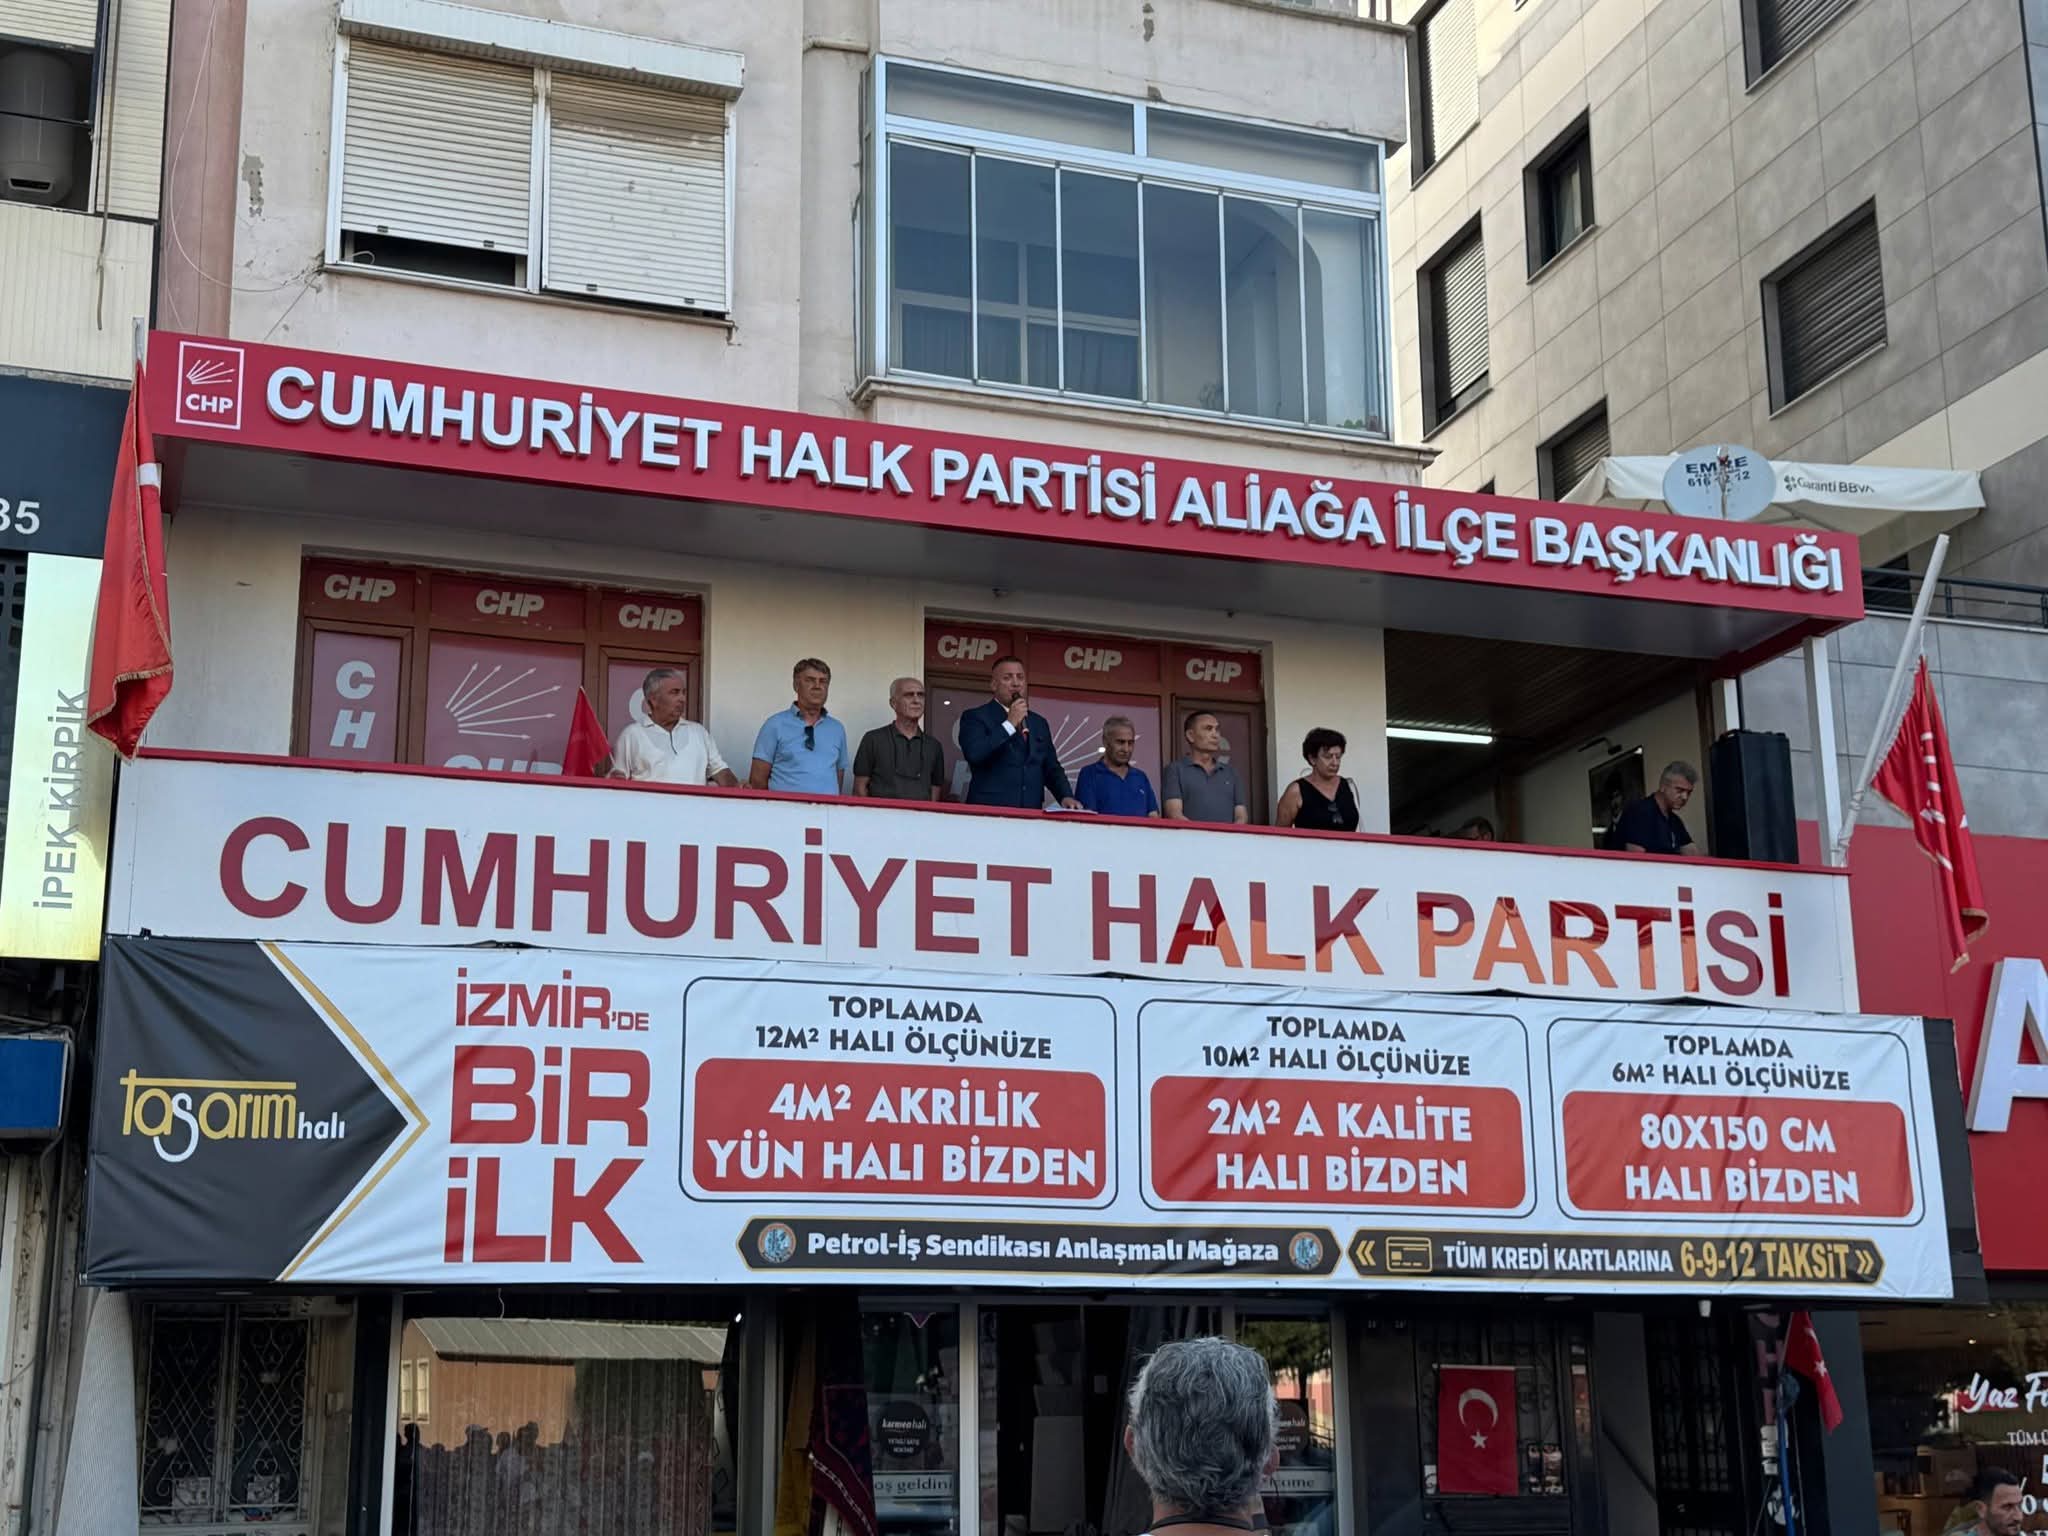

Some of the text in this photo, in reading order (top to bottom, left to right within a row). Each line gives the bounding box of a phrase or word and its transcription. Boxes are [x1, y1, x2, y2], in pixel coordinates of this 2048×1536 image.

[185, 392, 234, 414] CHP
[266, 366, 1844, 593] CUMHURİYET HALK PARTİSİ ALİAĞA İLÇE BAŞKANLIĞI
[1797, 476, 1837, 493] Garanti
[324, 573, 396, 603] CHP
[475, 589, 545, 618] CHP
[618, 604, 685, 632] CHP
[937, 635, 998, 661] CHP
[1063, 646, 1123, 672] CHP
[1185, 658, 1242, 684] CHP
[33, 689, 89, 909] İPEK KİRPİK
[219, 816, 1792, 998] CUMHURİYET HALK PARTİSİ
[828, 995, 983, 1025] TOPLAMDA
[756, 1026, 1052, 1062] 12M² HALI ÖLÇÜNÜZE
[1267, 1016, 1407, 1043] TOPLAMDA
[1663, 1034, 1795, 1060] TOPLAMDA
[1202, 1045, 1471, 1081] 10M² HALI ÖLÇÜNÜZE
[1612, 1062, 1851, 1093] 6M² HALI ÖLÇÜNÜZE
[120, 1068, 345, 1163] tasarım halı
[769, 1077, 1041, 1128] 4M² AKRİLİK
[1207, 1095, 1473, 1143] 2M² A KALİTE
[1640, 1113, 1837, 1154] 80X150 CM
[707, 1128, 1096, 1187] YÜN HALI BİZDEN
[1215, 1146, 1469, 1196] HALI BİZDEN
[1624, 1157, 1860, 1205] HALI BİZDEN
[807, 1230, 921, 1261] Petrol-İş
[925, 1232, 1050, 1259] Sendikası
[1055, 1236, 1183, 1265] Anlaşmalı
[1187, 1238, 1279, 1267] Mağaza
[1443, 1239, 1853, 1280] TÜM KREDİ KARTLARINA 6-9-12 TAKSİT
[1961, 1372, 2020, 1413] Yaz
